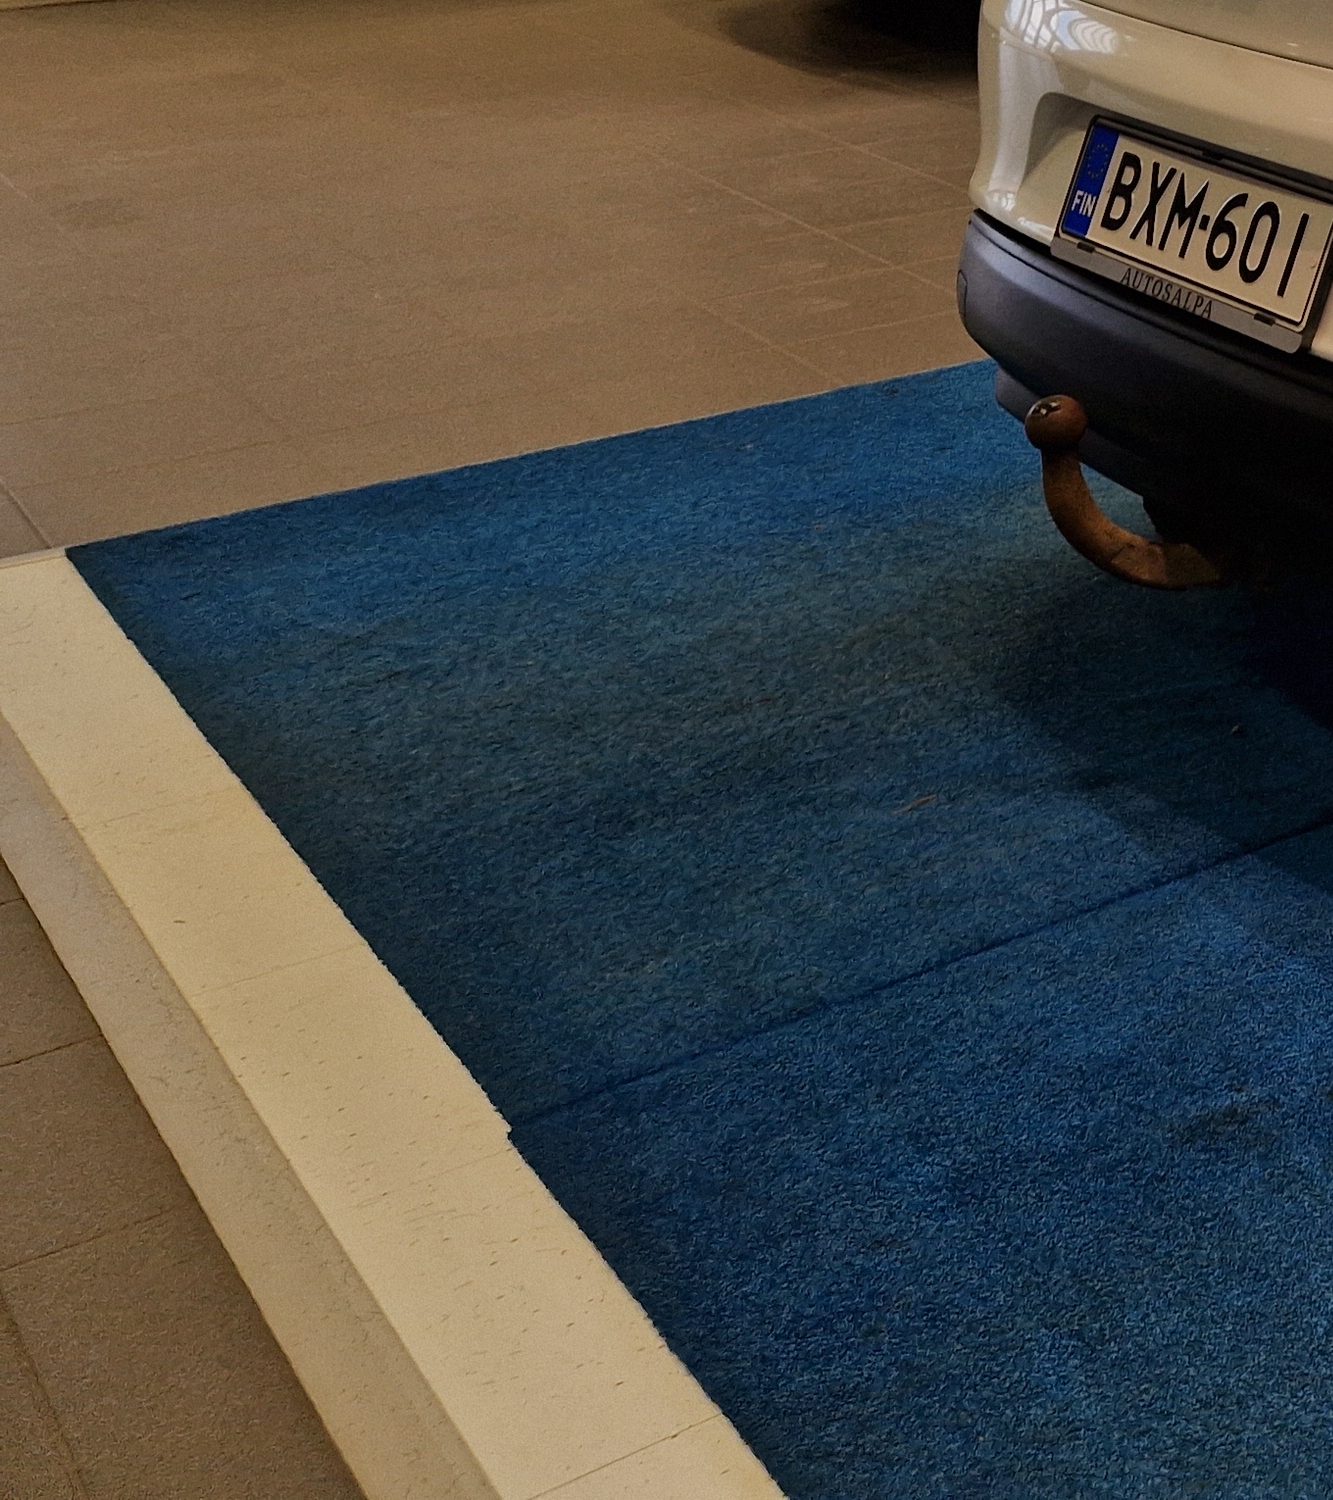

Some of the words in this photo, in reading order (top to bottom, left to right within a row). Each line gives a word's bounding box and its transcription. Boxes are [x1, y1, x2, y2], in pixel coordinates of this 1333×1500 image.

[1071, 189, 1099, 218] FIN
[1100, 151, 1310, 298] BXM-601
[1120, 267, 1213, 319] AUTOSALPA
